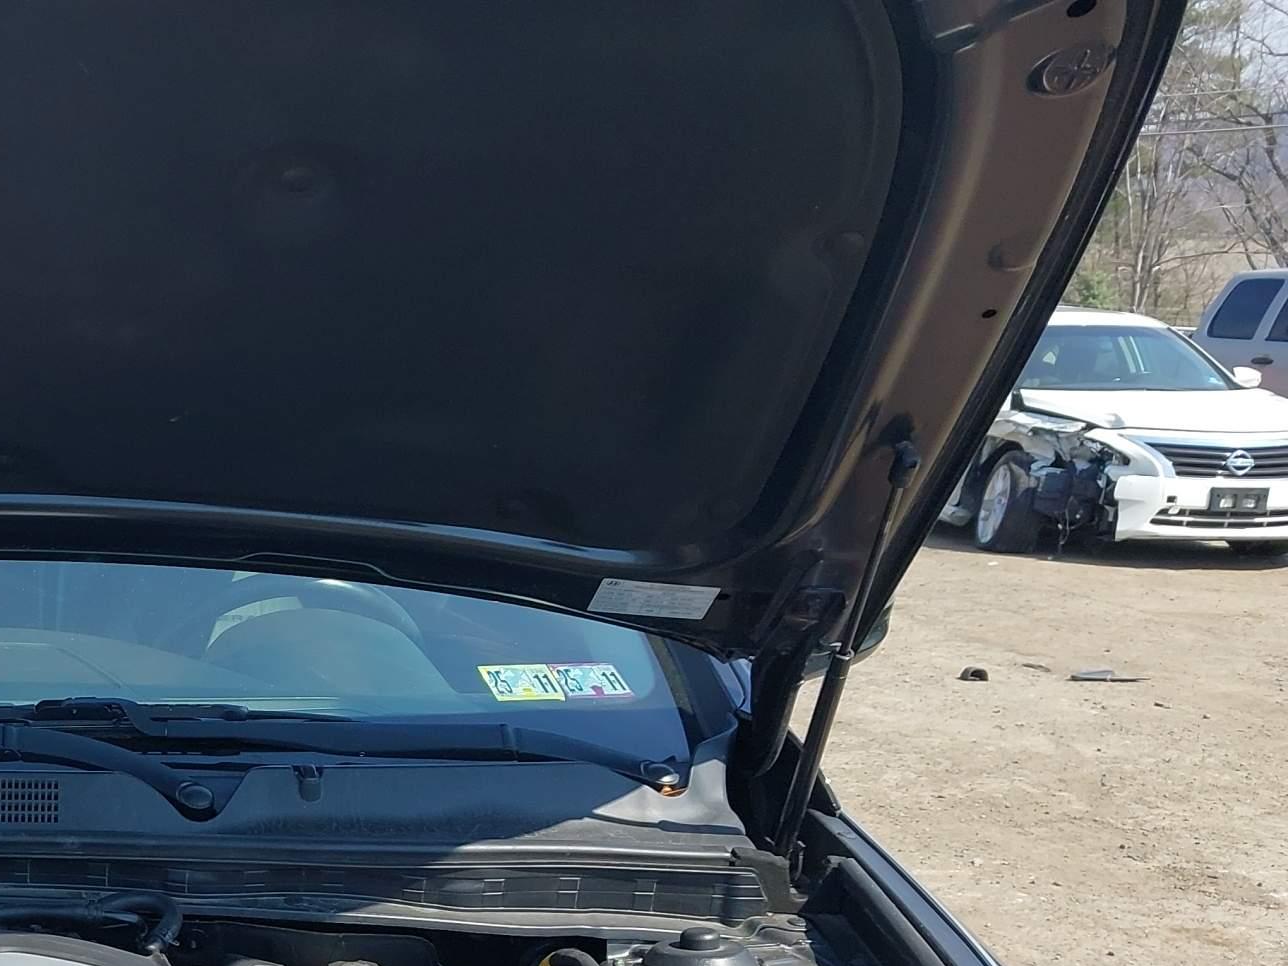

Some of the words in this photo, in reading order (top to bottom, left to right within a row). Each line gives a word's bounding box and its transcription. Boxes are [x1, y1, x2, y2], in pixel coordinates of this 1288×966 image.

[487, 670, 513, 694] 25
[533, 673, 558, 694] 11
[557, 669, 583, 692] 25
[602, 671, 626, 691] 11
